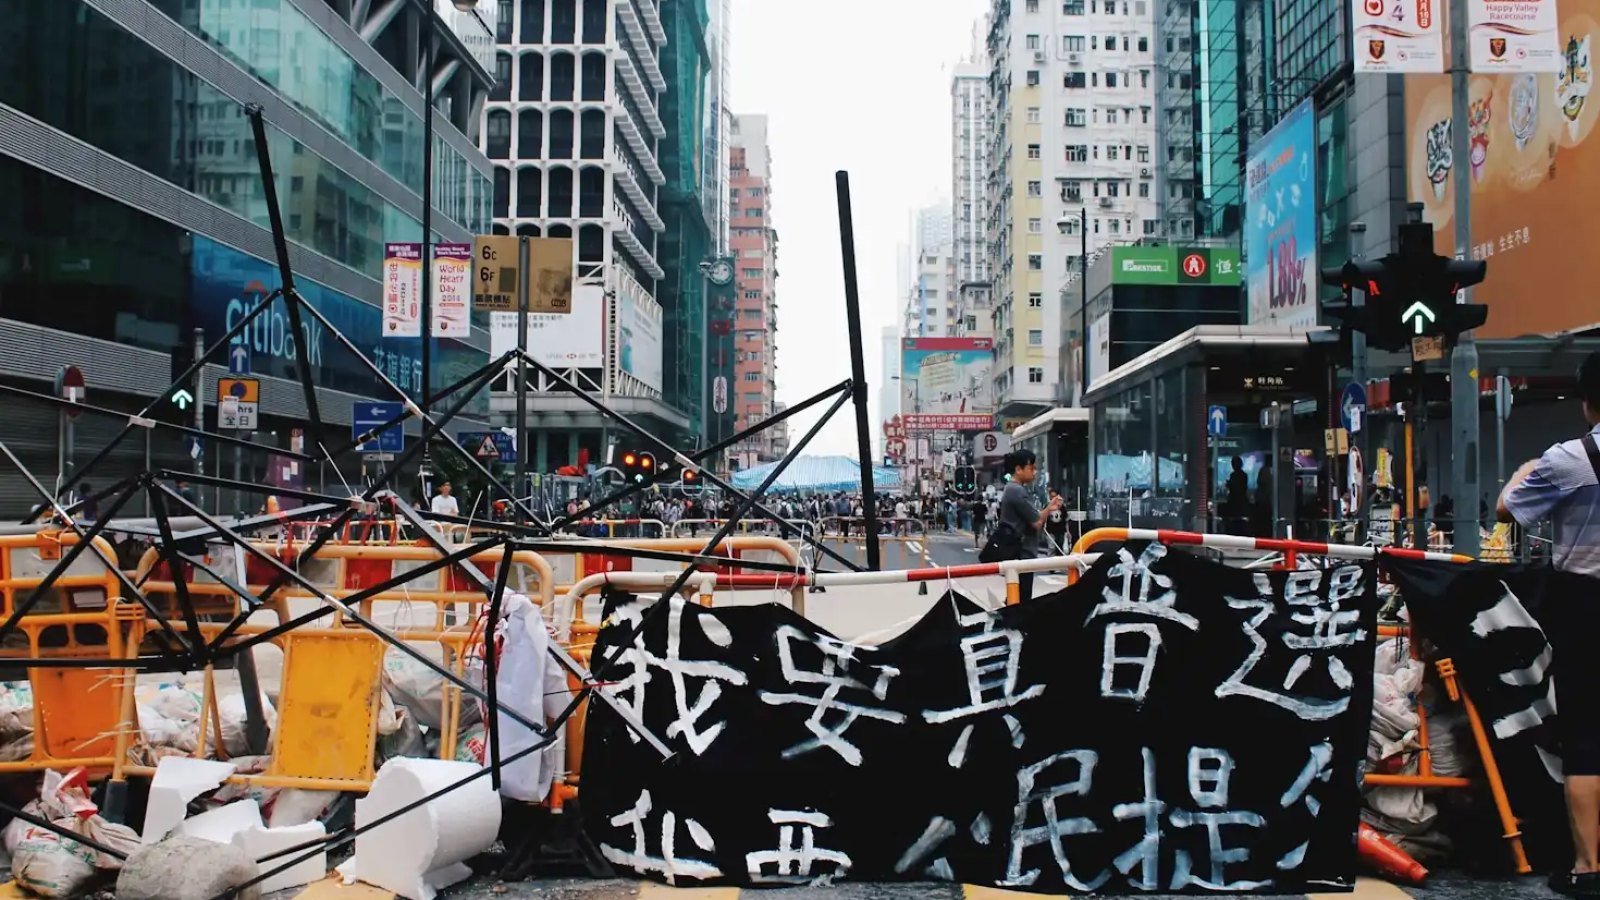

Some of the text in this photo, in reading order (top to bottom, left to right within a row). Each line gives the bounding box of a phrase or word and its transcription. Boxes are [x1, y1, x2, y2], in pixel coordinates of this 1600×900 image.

[1486, 4, 1539, 13] Happy Valley
[482, 245, 497, 260] 6C
[439, 264, 465, 273] World
[440, 274, 464, 283] Heart
[480, 267, 494, 282] 6F
[440, 284, 456, 294] Day
[226, 294, 322, 367] citibank
[238, 405, 253, 414] hrs
